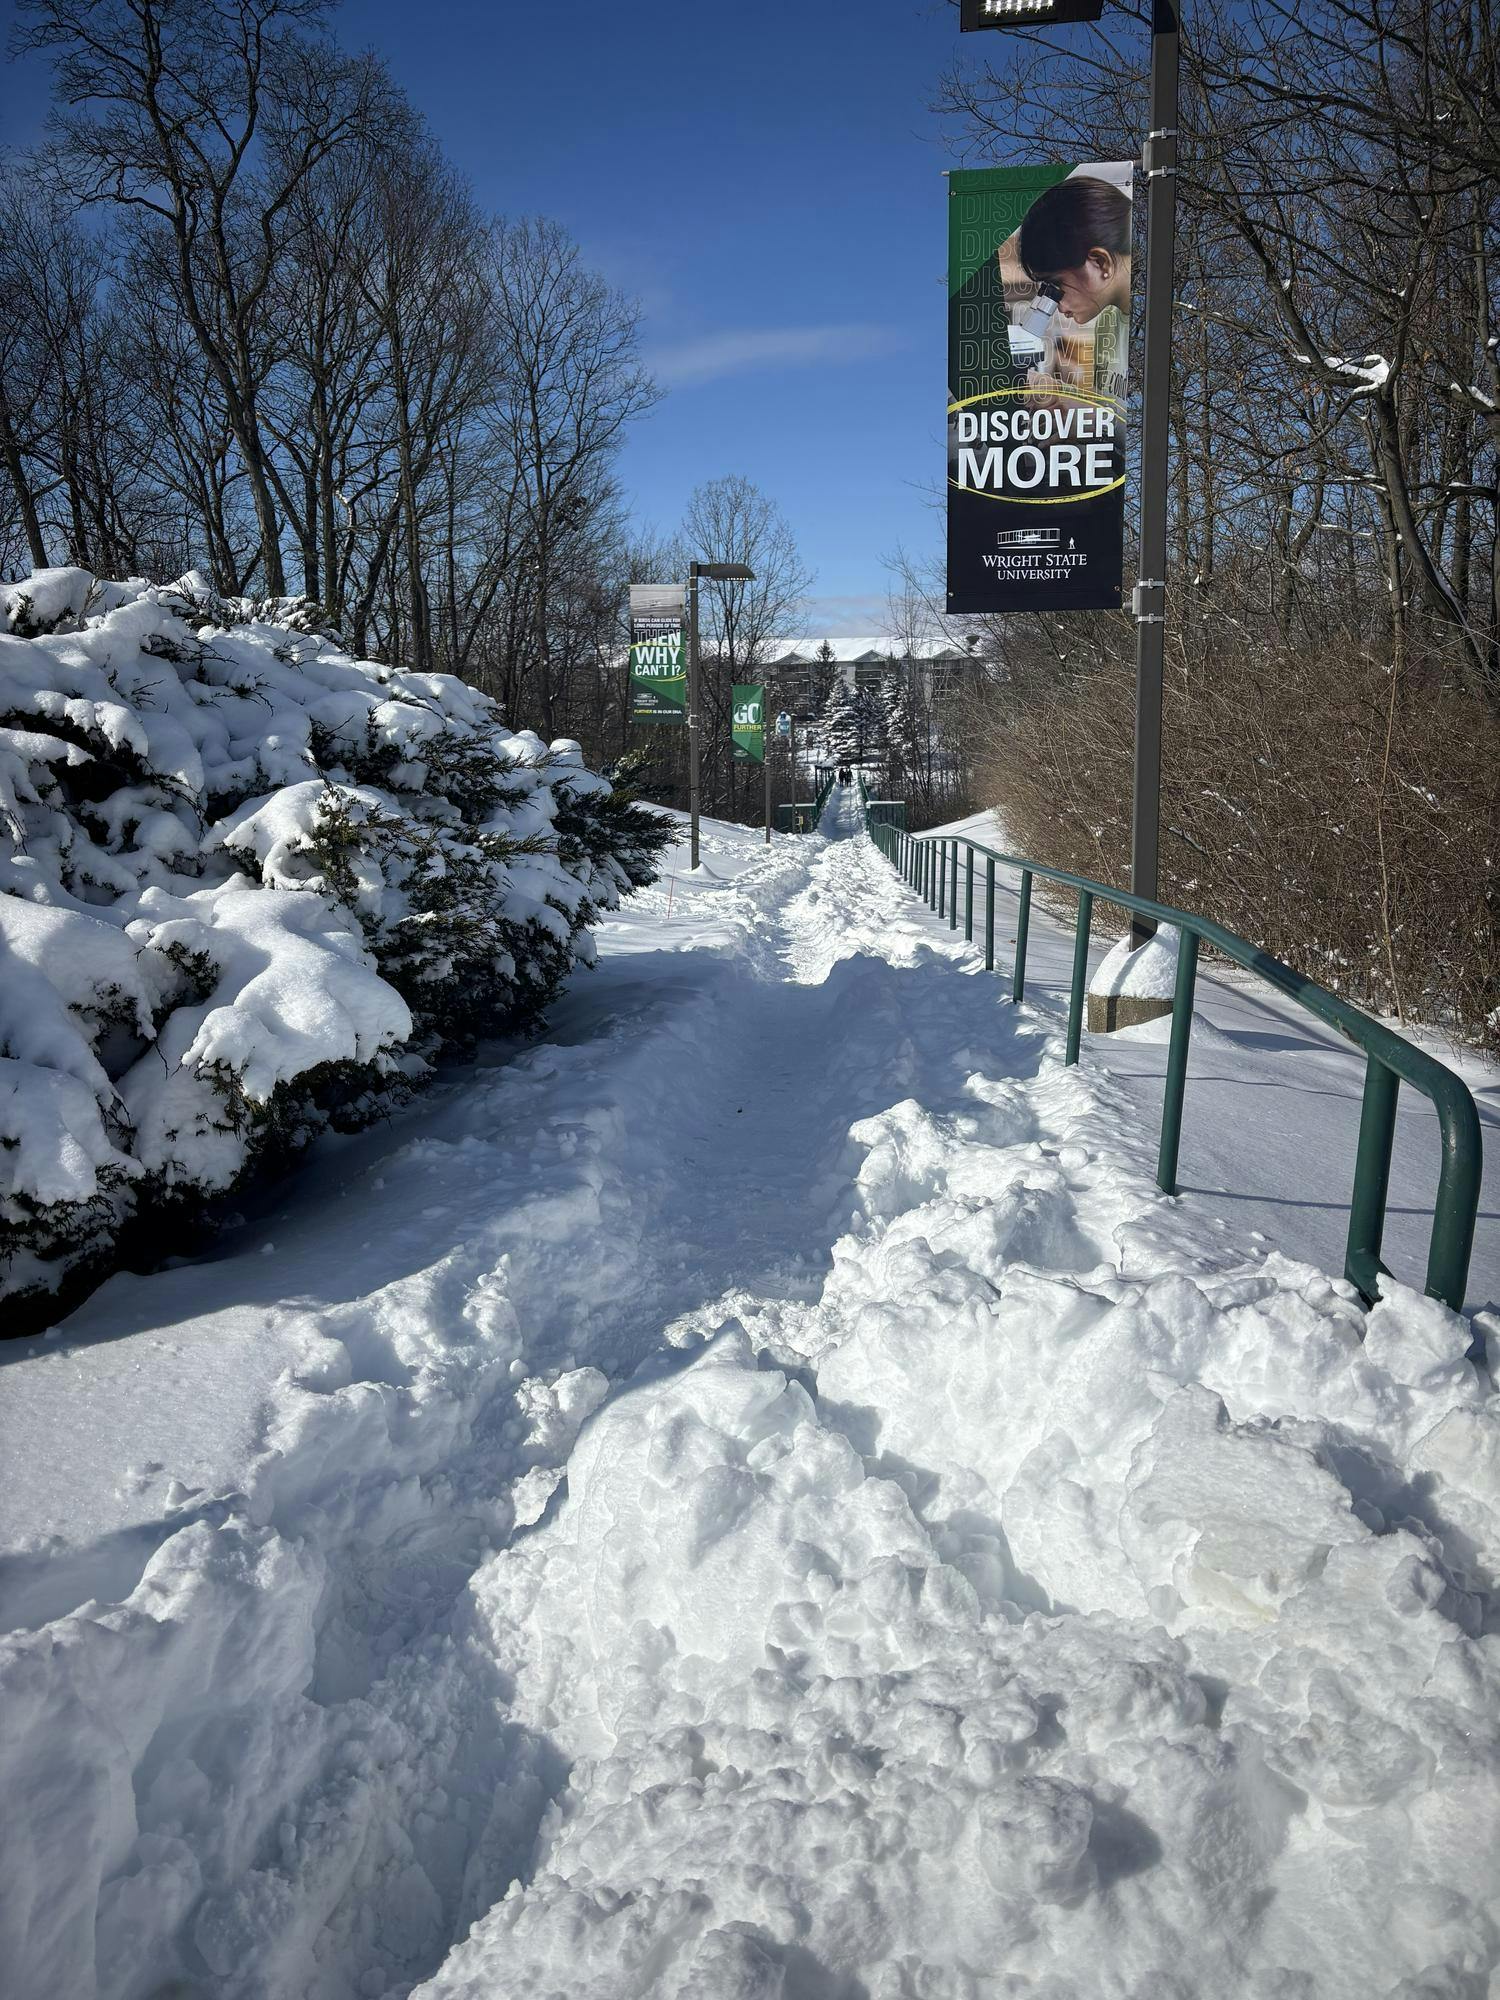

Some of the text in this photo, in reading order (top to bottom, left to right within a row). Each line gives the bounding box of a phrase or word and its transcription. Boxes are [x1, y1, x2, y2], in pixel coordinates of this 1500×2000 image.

[960, 227, 1018, 262] DIS
[960, 264, 1037, 299] DISC
[958, 406, 1116, 443] DISCOVER
[958, 443, 1115, 490] MORE
[982, 553, 1088, 569] WRIGHT STATE
[996, 568, 1071, 581] UNIVERSITY
[634, 629, 681, 646] THEN
[635, 646, 681, 665] WHY
[635, 664, 681, 676] CAN'T I?
[733, 702, 763, 724] GO
